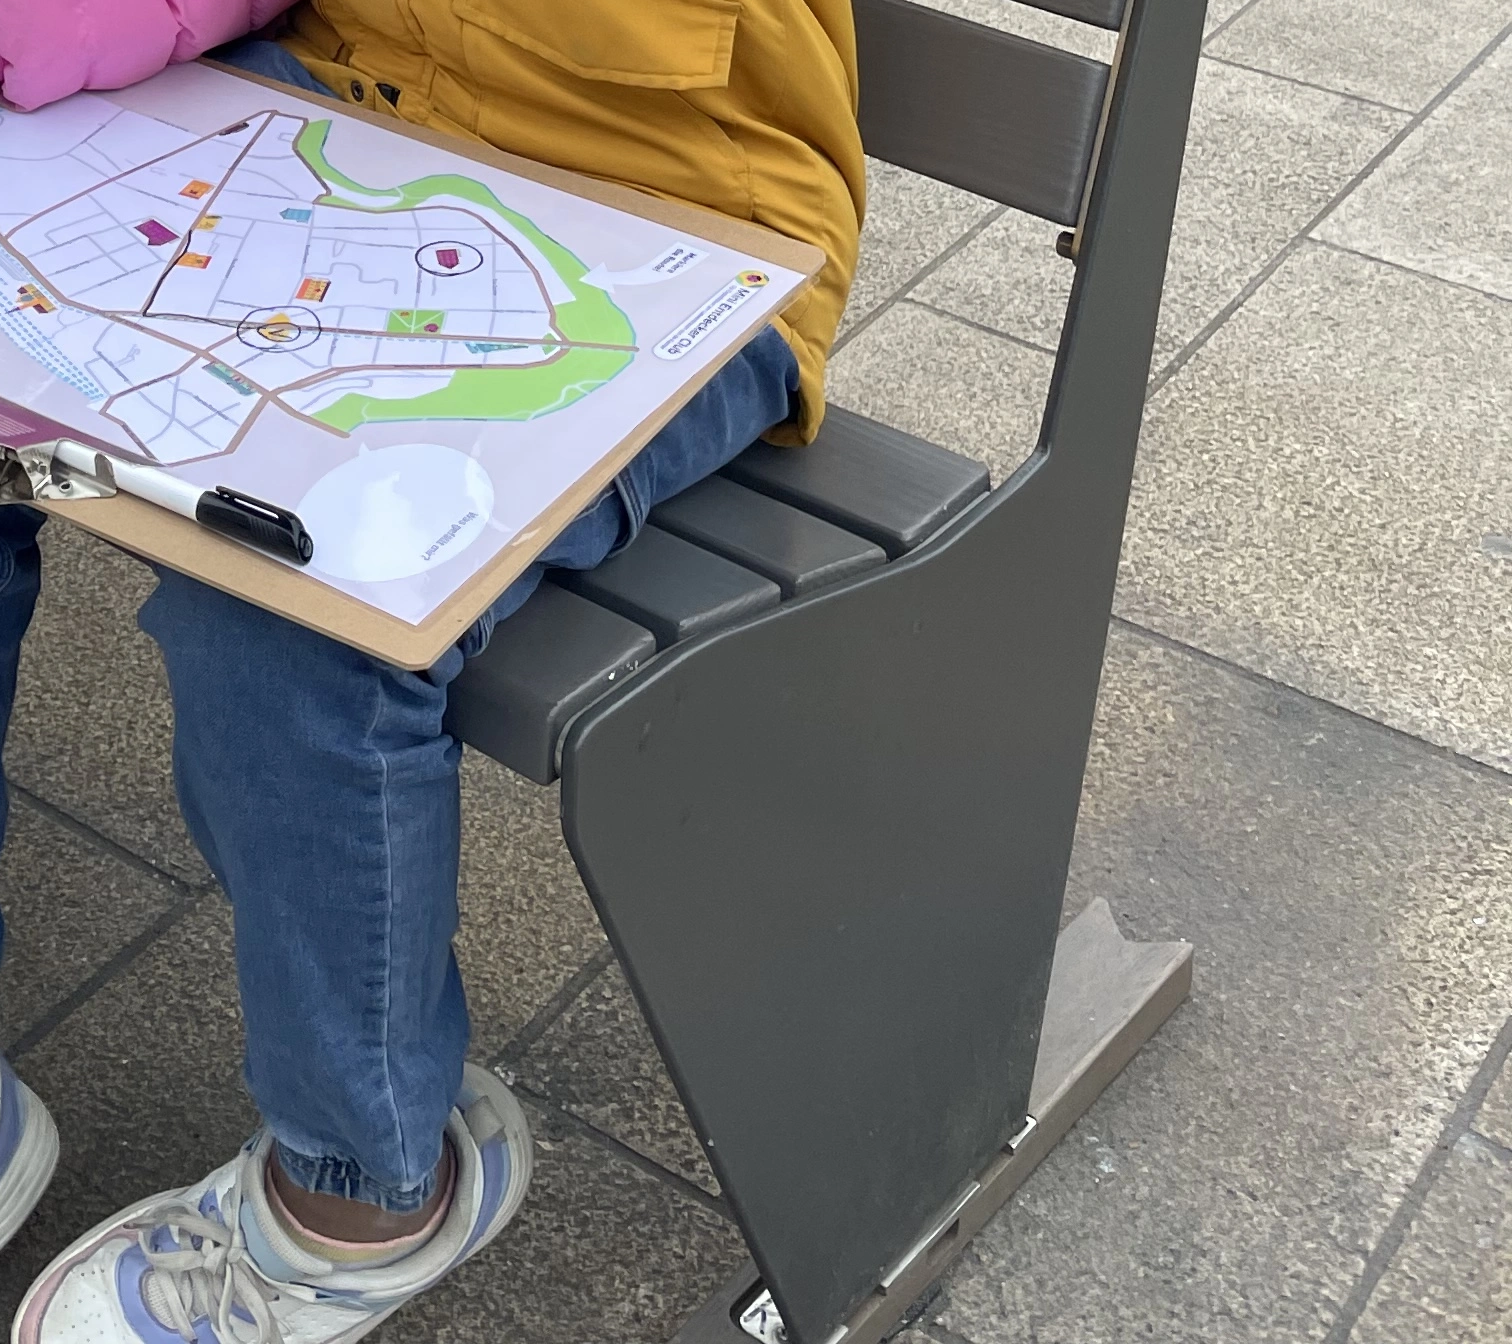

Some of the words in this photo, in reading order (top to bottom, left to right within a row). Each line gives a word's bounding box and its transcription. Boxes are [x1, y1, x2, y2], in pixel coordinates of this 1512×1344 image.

[726, 287, 750, 305] Mini
[688, 302, 732, 340] Entdecker
[667, 337, 692, 354] Club
